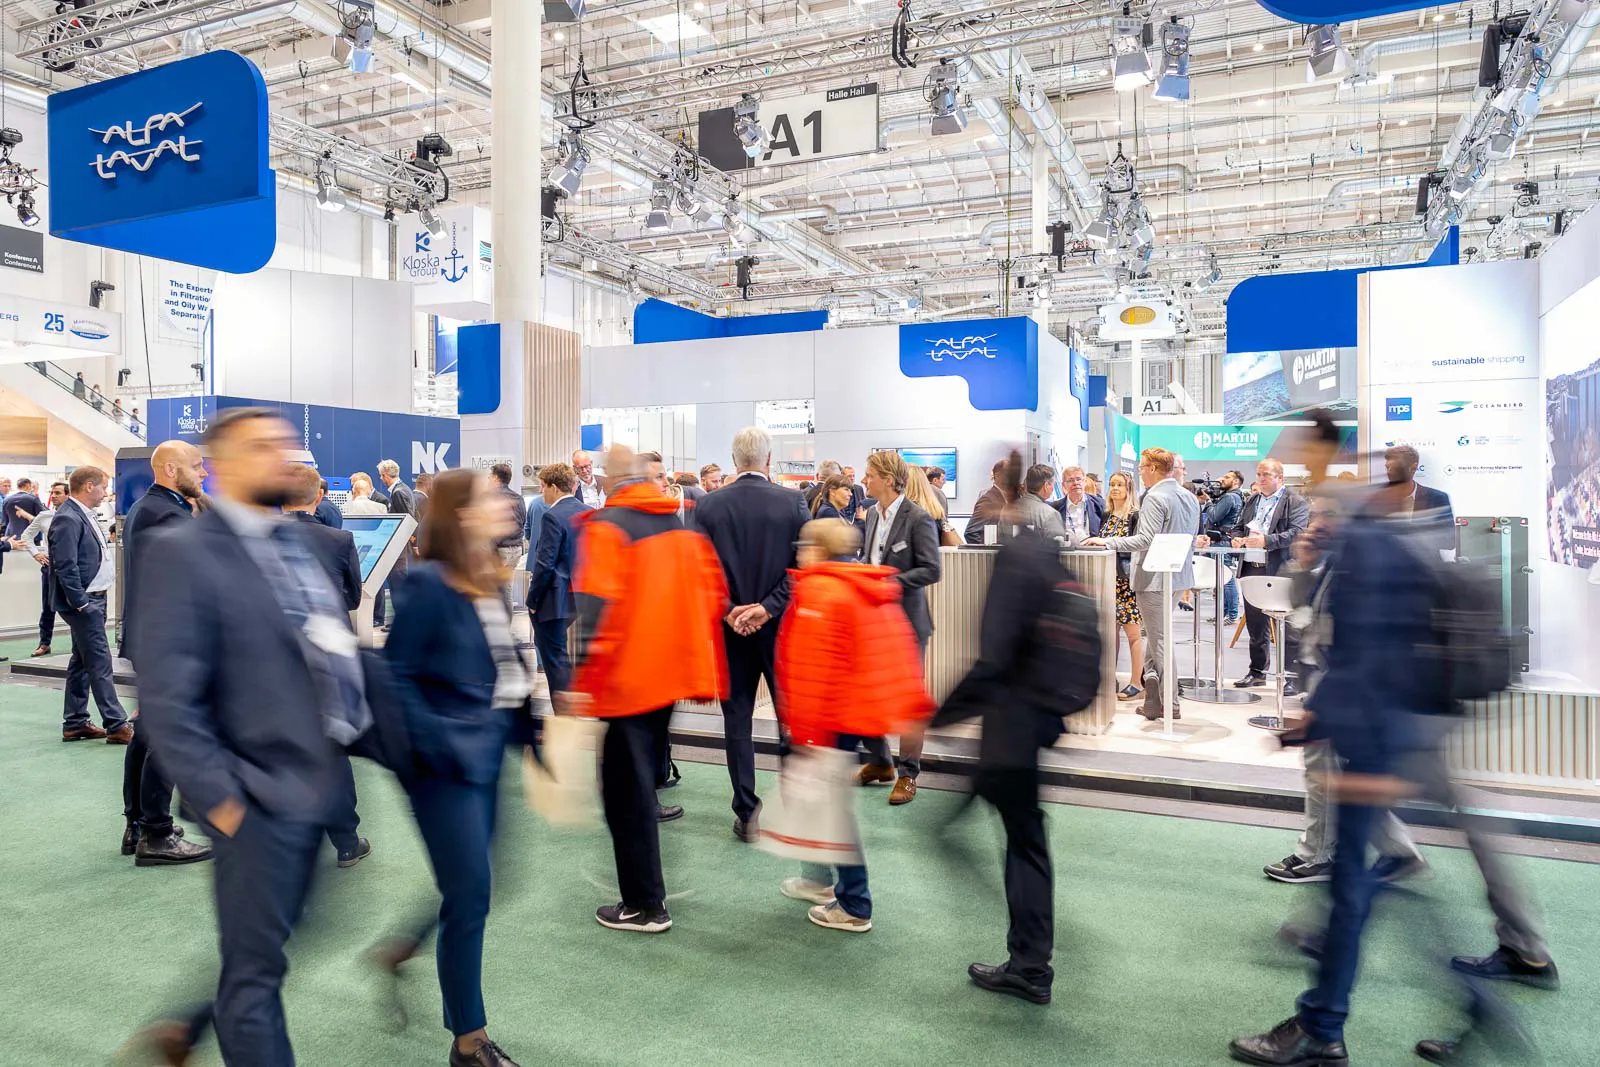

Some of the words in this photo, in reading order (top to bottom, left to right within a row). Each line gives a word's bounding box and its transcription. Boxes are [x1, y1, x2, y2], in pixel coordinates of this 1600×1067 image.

[828, 91, 848, 100] Halle
[850, 87, 866, 96] Hall
[89, 102, 203, 146] ALFA
[762, 109, 822, 161] A1
[89, 136, 203, 179] LAVAL
[403, 253, 440, 270] Kloska
[410, 266, 438, 278] Group
[169, 279, 184, 288] The
[180, 291, 211, 302] Filtratio
[164, 299, 179, 307] and
[181, 300, 196, 311] Oily
[44, 312, 65, 332] 25
[925, 333, 998, 349] ALFA
[925, 346, 998, 361] LAVAL
[1304, 348, 1336, 371] MARTIN
[1431, 356, 1485, 367] sustainable
[1487, 354, 1525, 364] shipping
[1143, 400, 1161, 412] A1
[1213, 432, 1258, 443] MARTIN
[411, 441, 451, 474] NK
